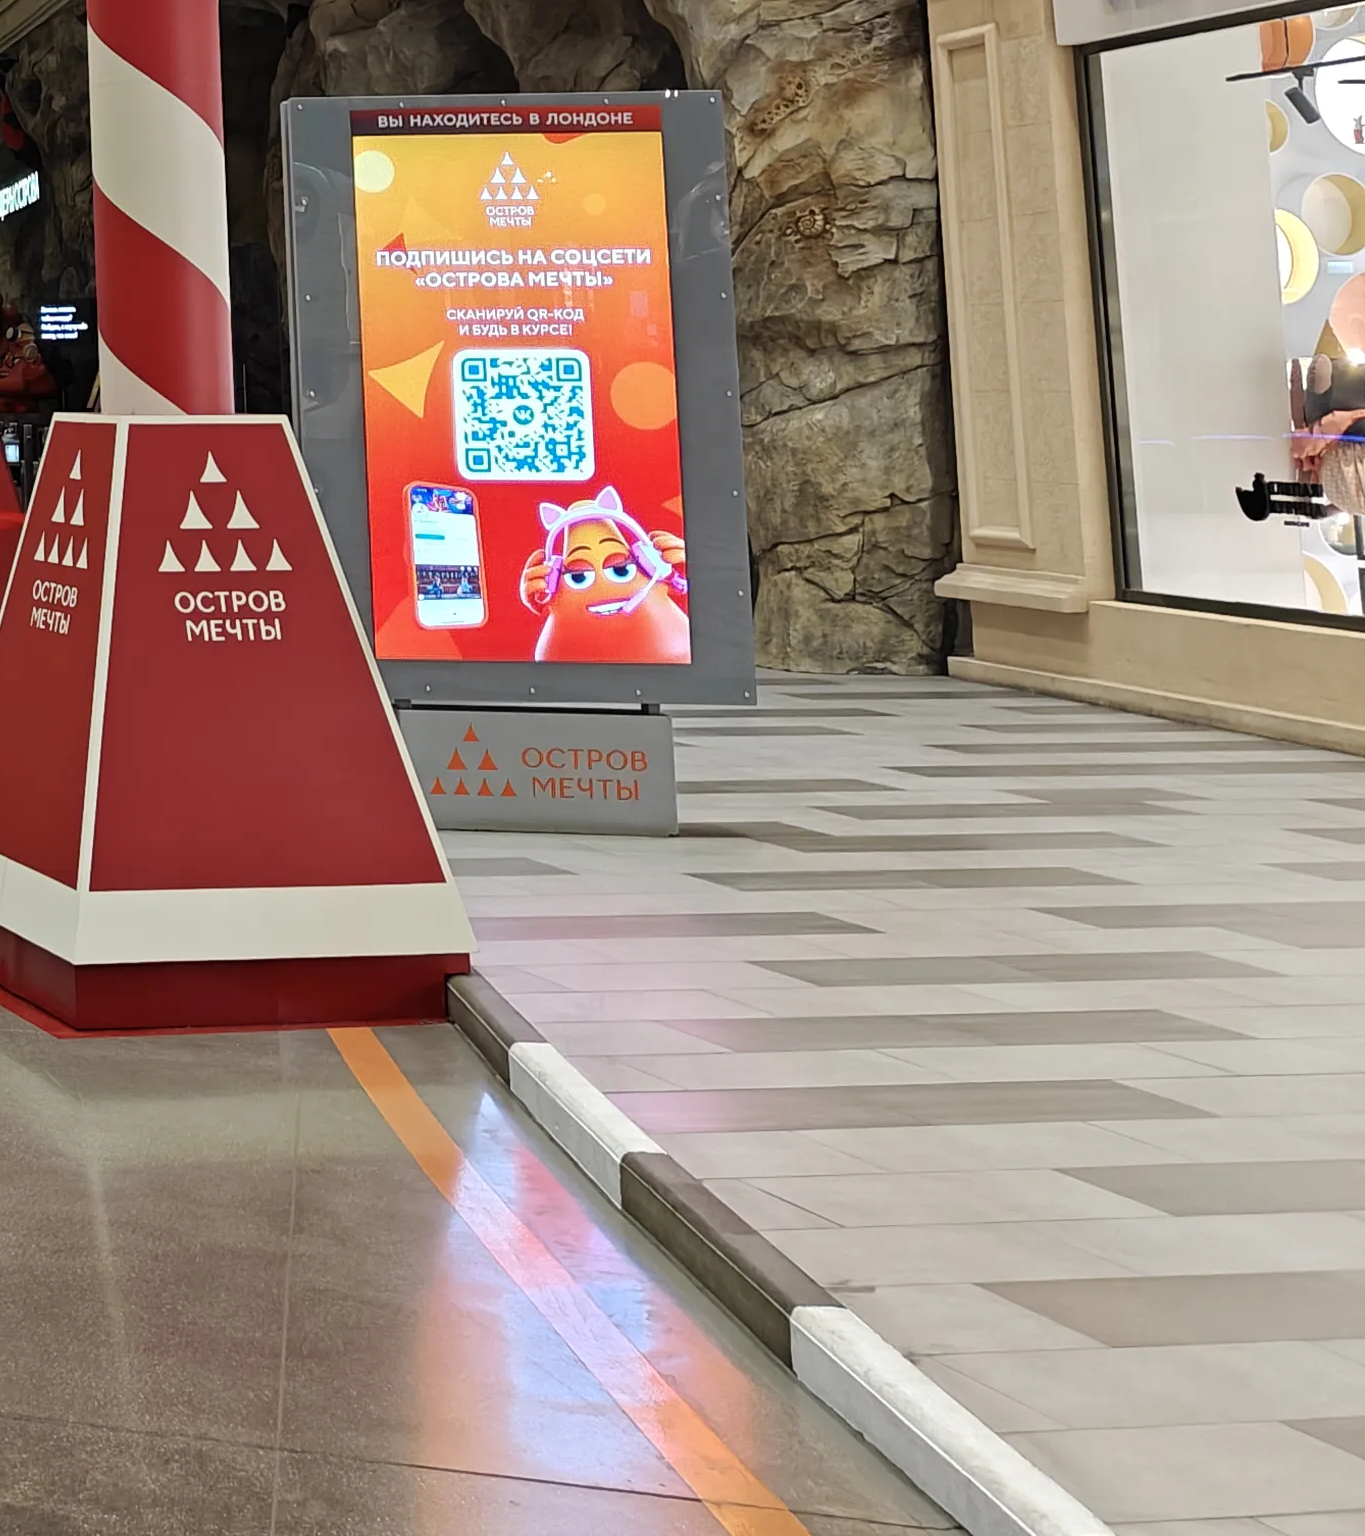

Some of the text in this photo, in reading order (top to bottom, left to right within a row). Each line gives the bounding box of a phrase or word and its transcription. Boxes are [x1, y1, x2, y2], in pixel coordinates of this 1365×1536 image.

[378, 112, 633, 129] ВЫ НАХОДИТЕСЬ В ЛОНДОНЕ
[485, 206, 535, 216] ОСТРОВ
[489, 216, 532, 227] МЕЧТЫ
[376, 248, 651, 268] ПОДПИШИСЬ НА СОЦСЕТИ
[415, 271, 613, 288] «ОСТРОВА МЕЧТЫ»
[446, 306, 585, 322] СКАНИРУЙ QR-КОД
[459, 323, 573, 337] И БУДЬ В КУРСЕ!
[32, 579, 78, 608] ОСТРОВ
[174, 590, 286, 613] ОСТРОВ
[30, 606, 71, 635] МЕЧТЫ
[185, 618, 282, 642] МЕЧТЫ
[521, 747, 648, 772] ОСТРОВ
[532, 776, 640, 801] МЕЧТЫ
